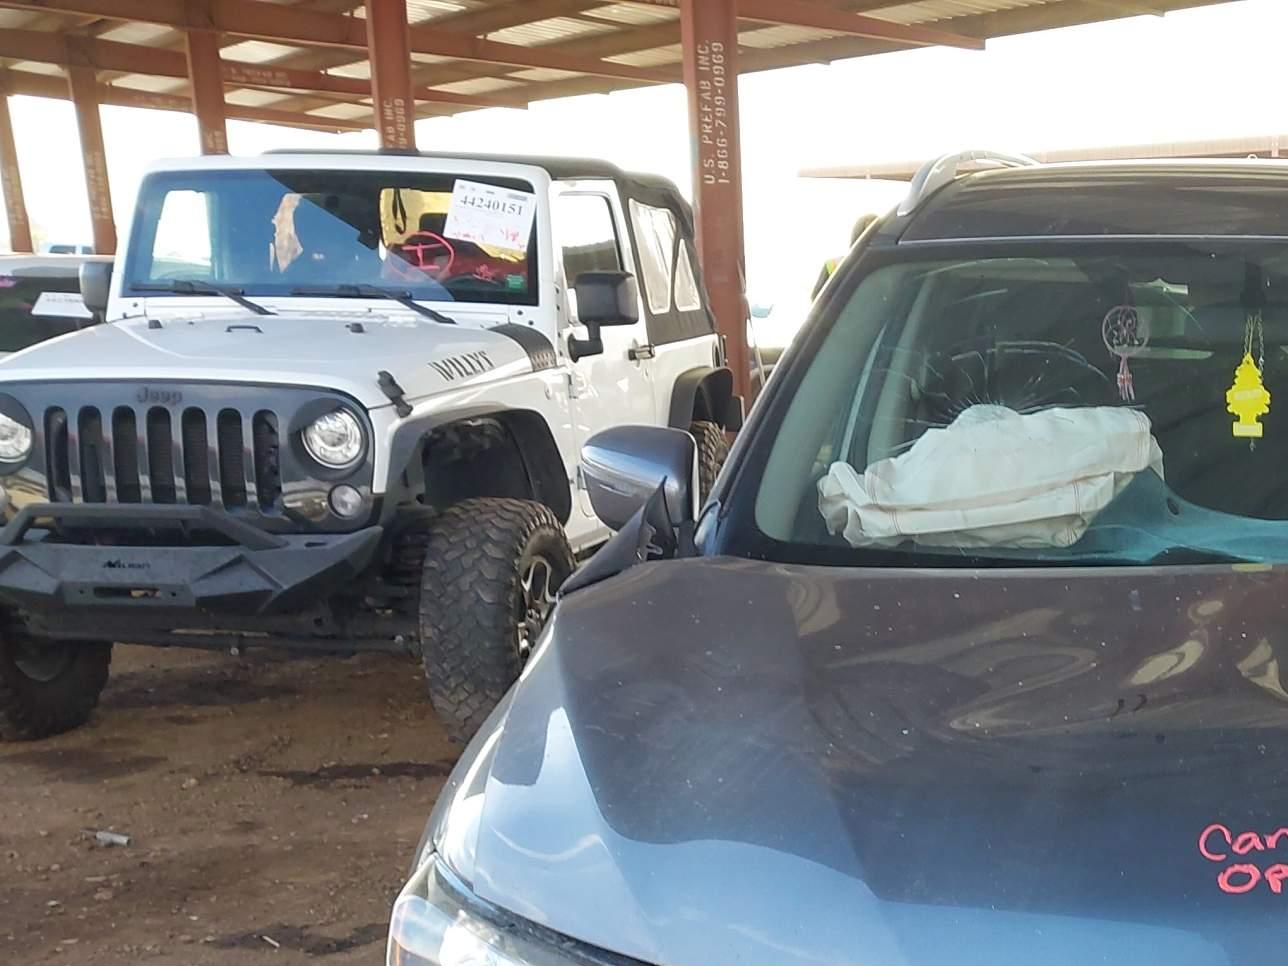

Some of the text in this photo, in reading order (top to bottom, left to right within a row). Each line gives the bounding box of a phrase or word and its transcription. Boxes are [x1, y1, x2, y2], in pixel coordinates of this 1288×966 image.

[699, 80, 713, 144] PREFAB
[711, 42, 730, 184] 1-866-799-0969
[460, 195, 523, 215] 44240151
[428, 351, 494, 381] WILLYS
